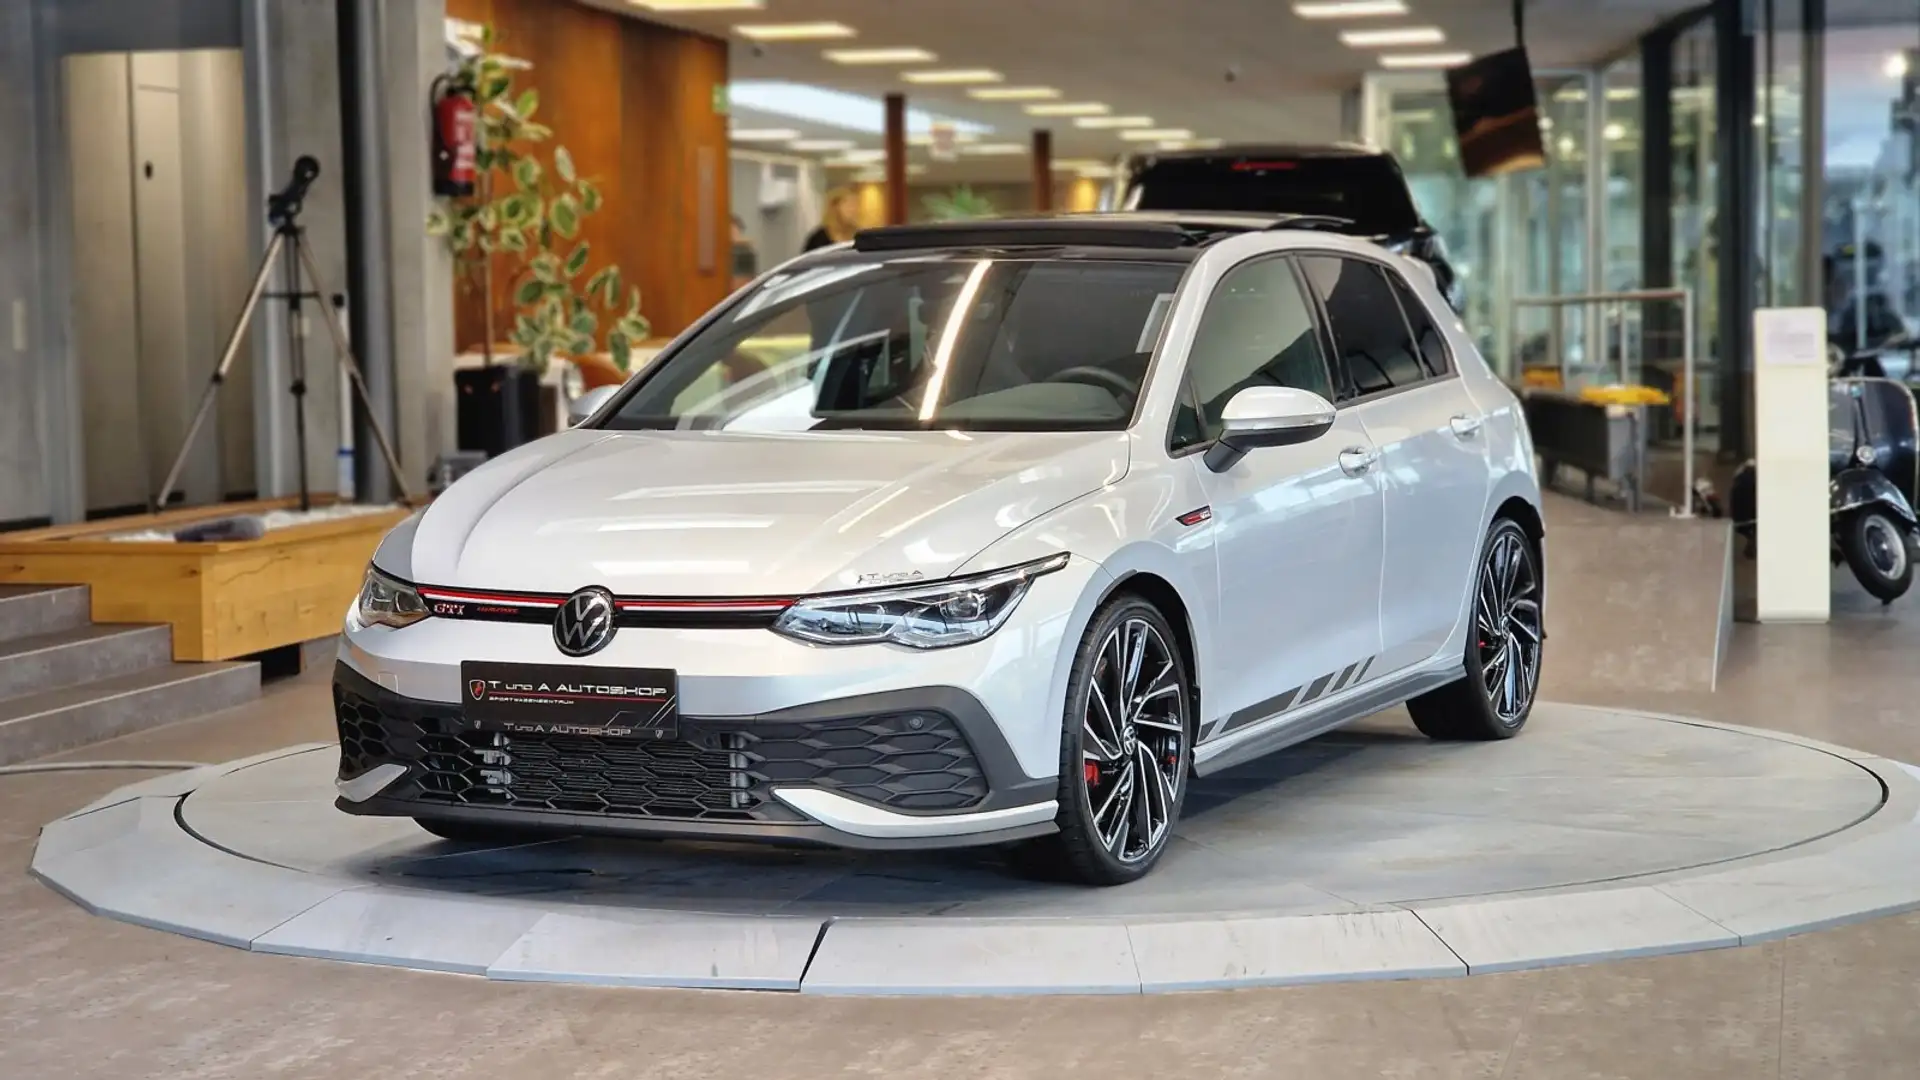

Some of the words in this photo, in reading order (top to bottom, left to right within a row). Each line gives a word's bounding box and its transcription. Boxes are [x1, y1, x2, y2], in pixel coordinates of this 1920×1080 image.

[434, 603, 465, 615] GTI
[487, 680, 501, 689] T
[537, 682, 551, 692] A
[555, 683, 667, 696] AUTOSHOP
[549, 724, 632, 736] AUTOSHOP
